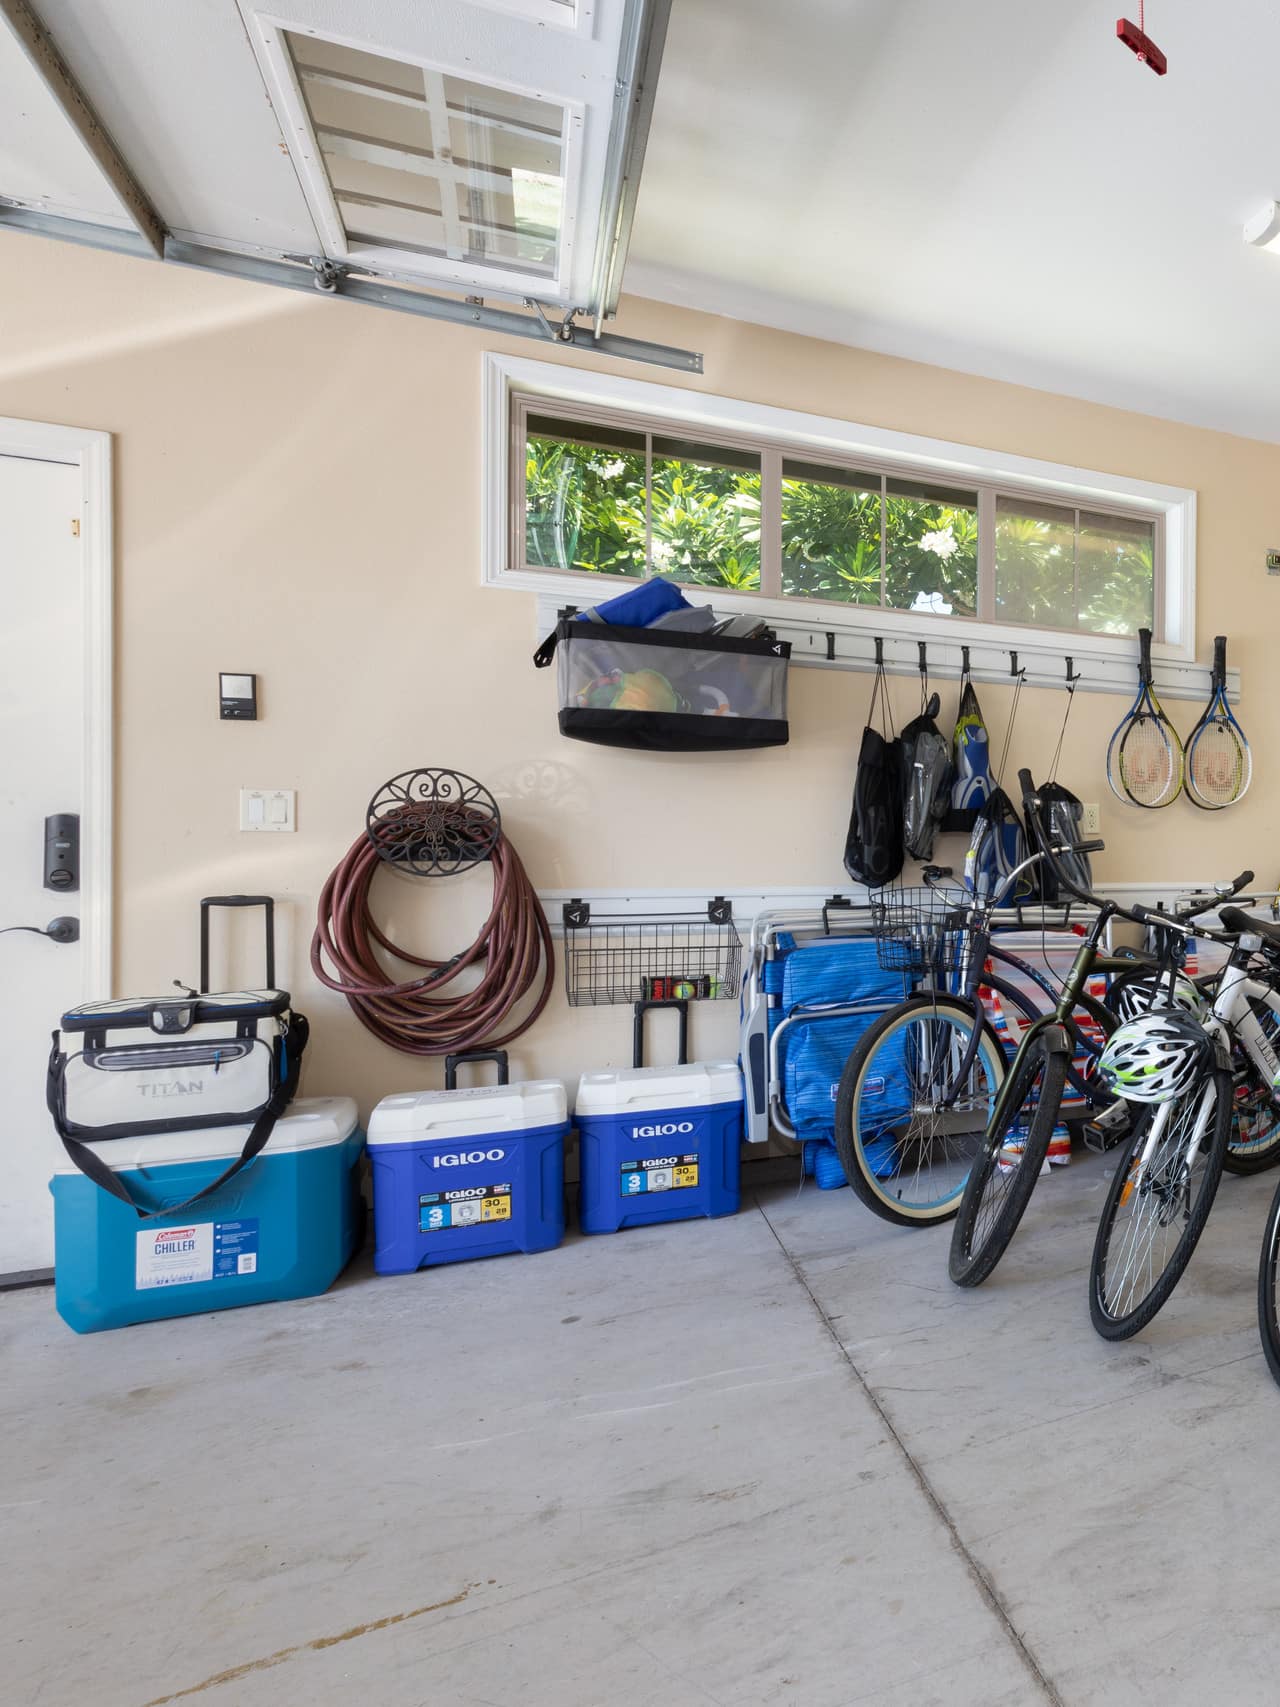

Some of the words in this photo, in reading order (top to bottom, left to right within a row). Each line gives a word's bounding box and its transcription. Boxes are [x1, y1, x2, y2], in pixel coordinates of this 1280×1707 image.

[136, 1080, 204, 1097] TITAN
[632, 1122, 694, 1139] IGLOO
[433, 1149, 505, 1168] IGLOO
[642, 1156, 678, 1168] IGLOO
[676, 1167, 689, 1175] 30
[628, 1175, 641, 1187] 3
[445, 1187, 487, 1200] IGLOO
[485, 1198, 500, 1208] 30
[429, 1208, 443, 1221] 3
[154, 1240, 195, 1255] CHILLER
